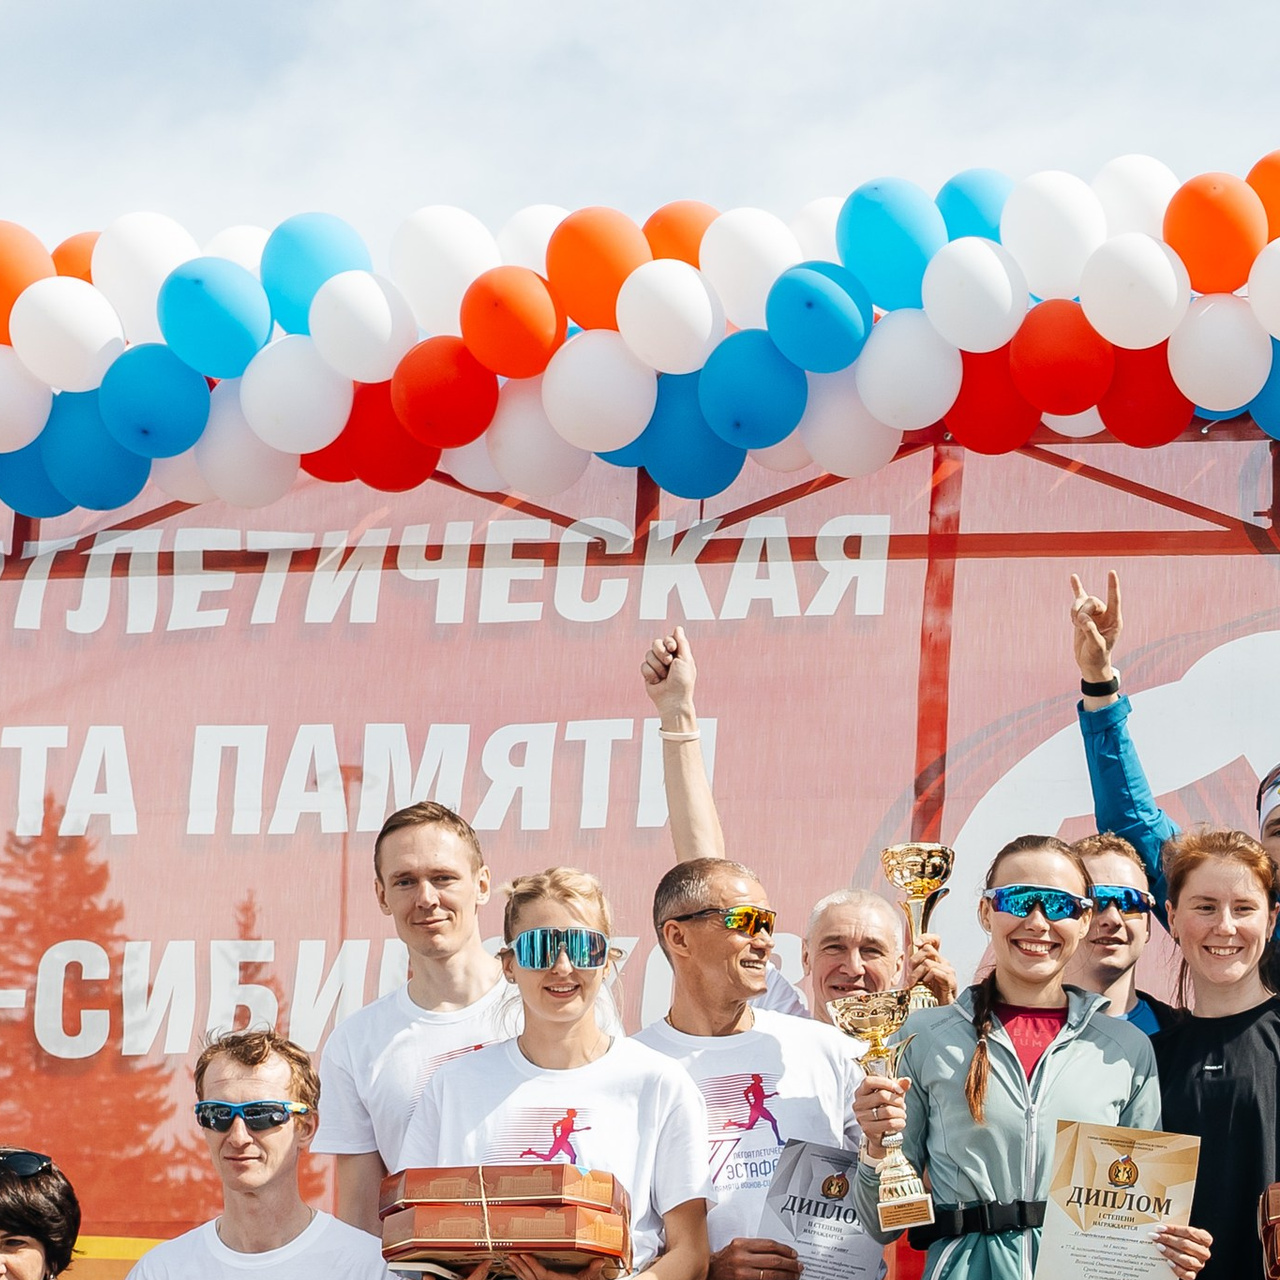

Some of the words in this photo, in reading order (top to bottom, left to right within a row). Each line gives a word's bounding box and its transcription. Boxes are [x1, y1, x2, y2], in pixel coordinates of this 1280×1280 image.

[0, 514, 891, 635] ТЛЕТИЧЕСКАЯ
[0, 725, 138, 837] ТА
[726, 1159, 778, 1180] ЭСТАФЕ
[780, 1195, 862, 1226] ДИПЛО
[1065, 1186, 1173, 1215] ДИПЛОМ
[1092, 1220, 1138, 1231] НАГРАЖДАЕТСЯ
[1102, 1213, 1135, 1222] СТЕПЕНИ
